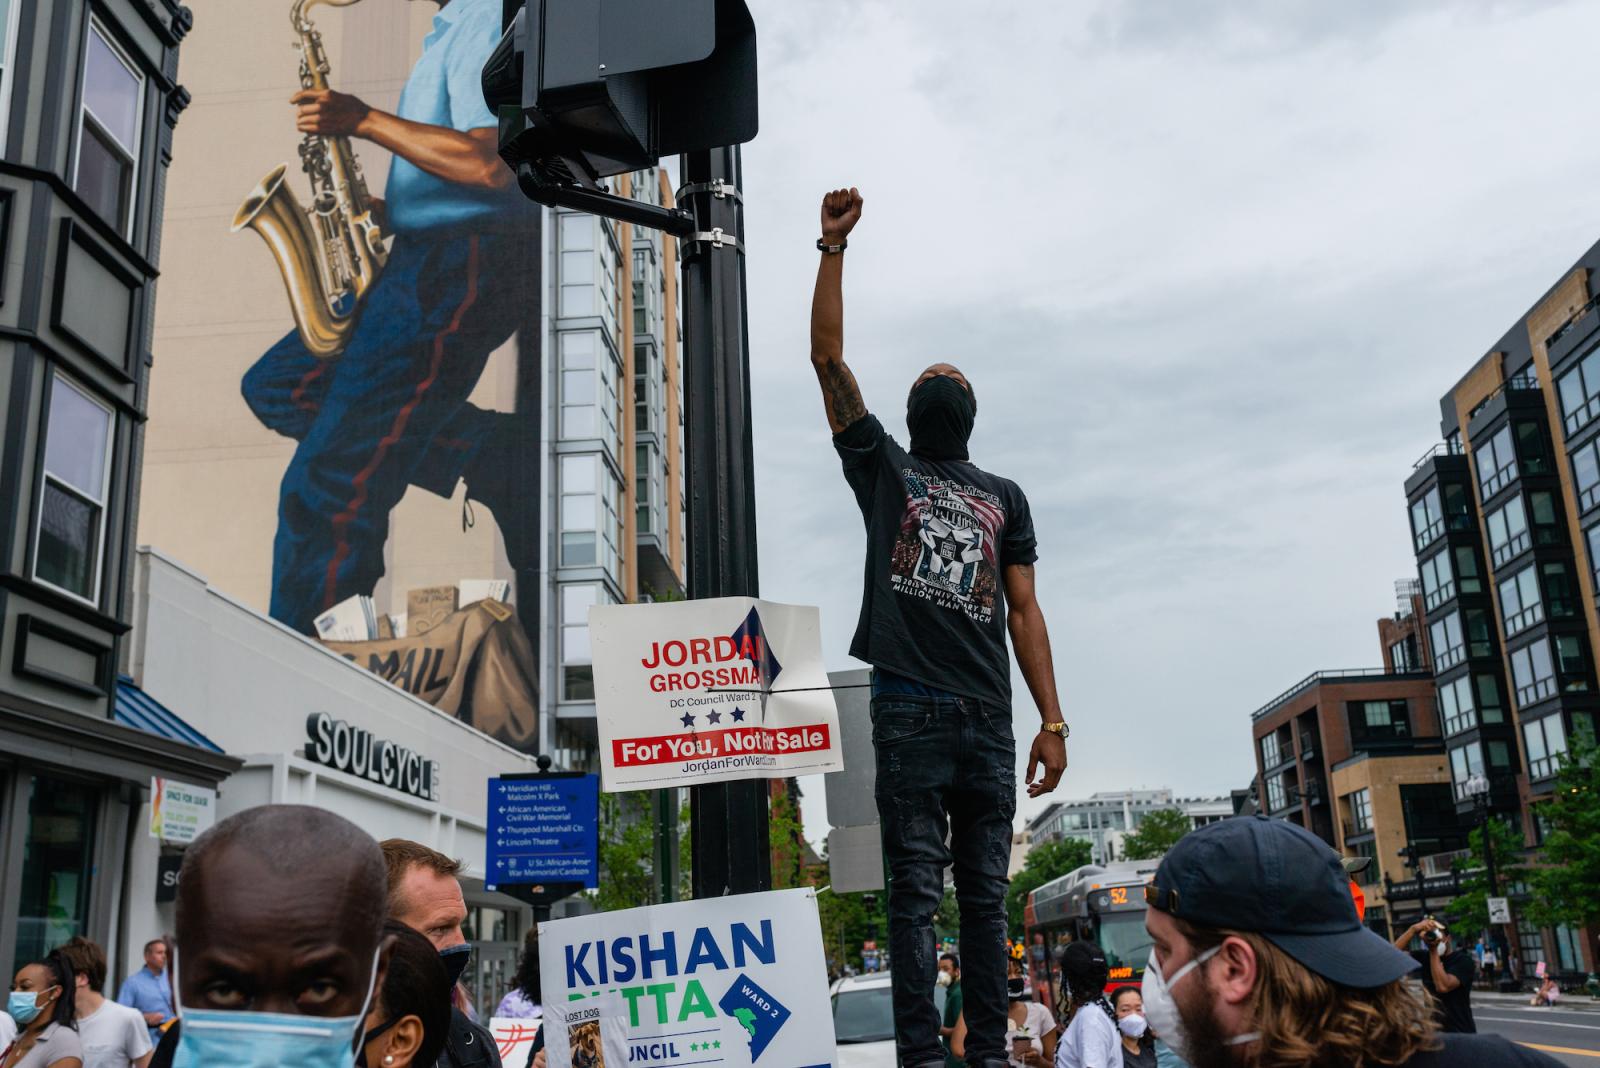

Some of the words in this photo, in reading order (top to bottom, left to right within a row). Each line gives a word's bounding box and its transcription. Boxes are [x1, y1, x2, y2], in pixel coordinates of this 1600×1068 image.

[892, 583, 932, 601] MILLION
[936, 599, 960, 610] MAN
[367, 647, 449, 695] MAIL
[649, 666, 765, 693] GROSSMA
[669, 698, 685, 709] DC
[686, 694, 725, 707] Council
[725, 693, 751, 703] Ward
[751, 692, 757, 701] 2
[621, 742, 662, 763] For
[665, 736, 719, 760] You,
[723, 730, 762, 753] Not
[761, 732, 775, 751] For
[775, 729, 824, 751] Sale
[304, 711, 441, 801] SOULCYCLE
[507, 784, 538, 793] Meridian
[507, 792, 537, 801] Malcolm
[544, 792, 560, 800] Park
[506, 805, 532, 814] African
[506, 814, 521, 822] Civil
[521, 814, 537, 822] War
[537, 813, 571, 821] Memorial
[506, 825, 541, 835] Thurgood
[542, 824, 572, 833] Marshall
[506, 838, 532, 847] Lincoln
[532, 838, 559, 846] Theatre
[163, 871, 182, 887] S
[1110, 888, 1128, 904] 52
[564, 918, 776, 989] KISHAN
[568, 979, 717, 1028] TTA
[740, 984, 771, 1012] WARD
[769, 1009, 779, 1019] 2
[564, 1011, 583, 1024] LOST
[584, 1007, 600, 1019] DOG
[628, 1041, 680, 1062] UNCIL
